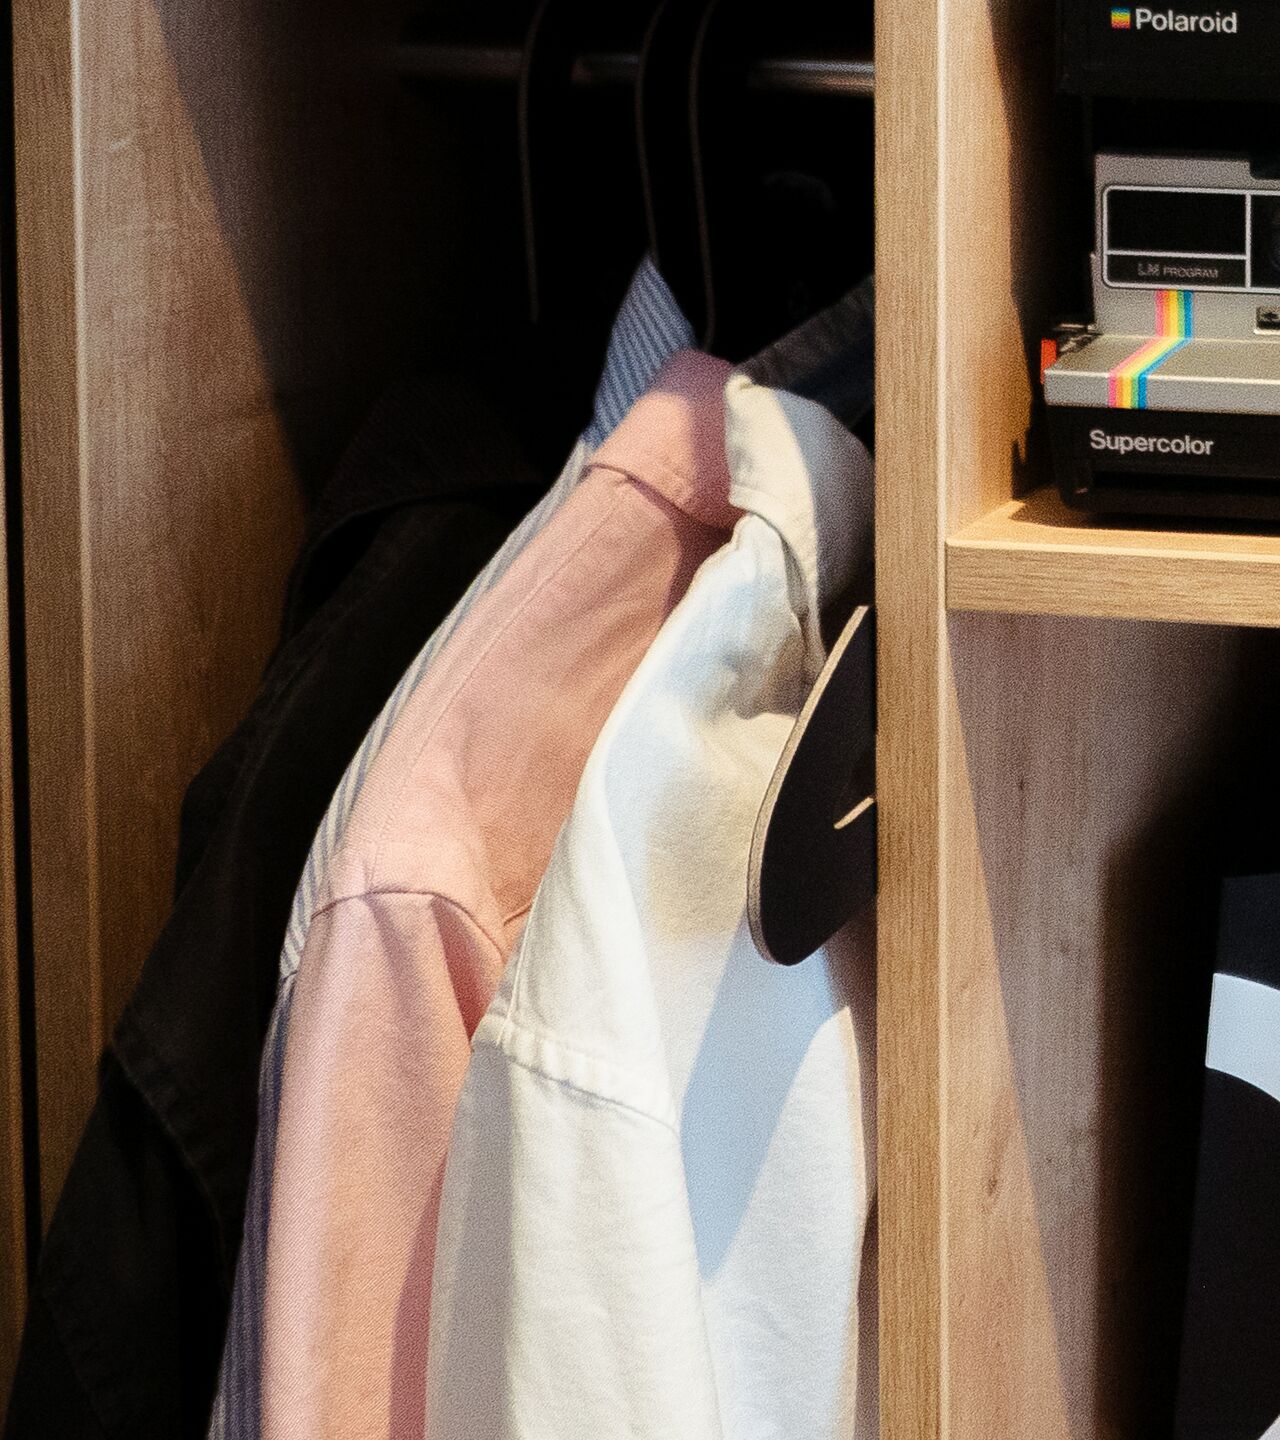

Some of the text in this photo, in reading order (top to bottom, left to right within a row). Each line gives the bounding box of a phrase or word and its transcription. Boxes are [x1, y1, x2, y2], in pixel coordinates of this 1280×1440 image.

[1135, 8, 1238, 34] Polaroid
[1163, 266, 1219, 279] PROGRAM
[1089, 429, 1214, 456] Supercolor
